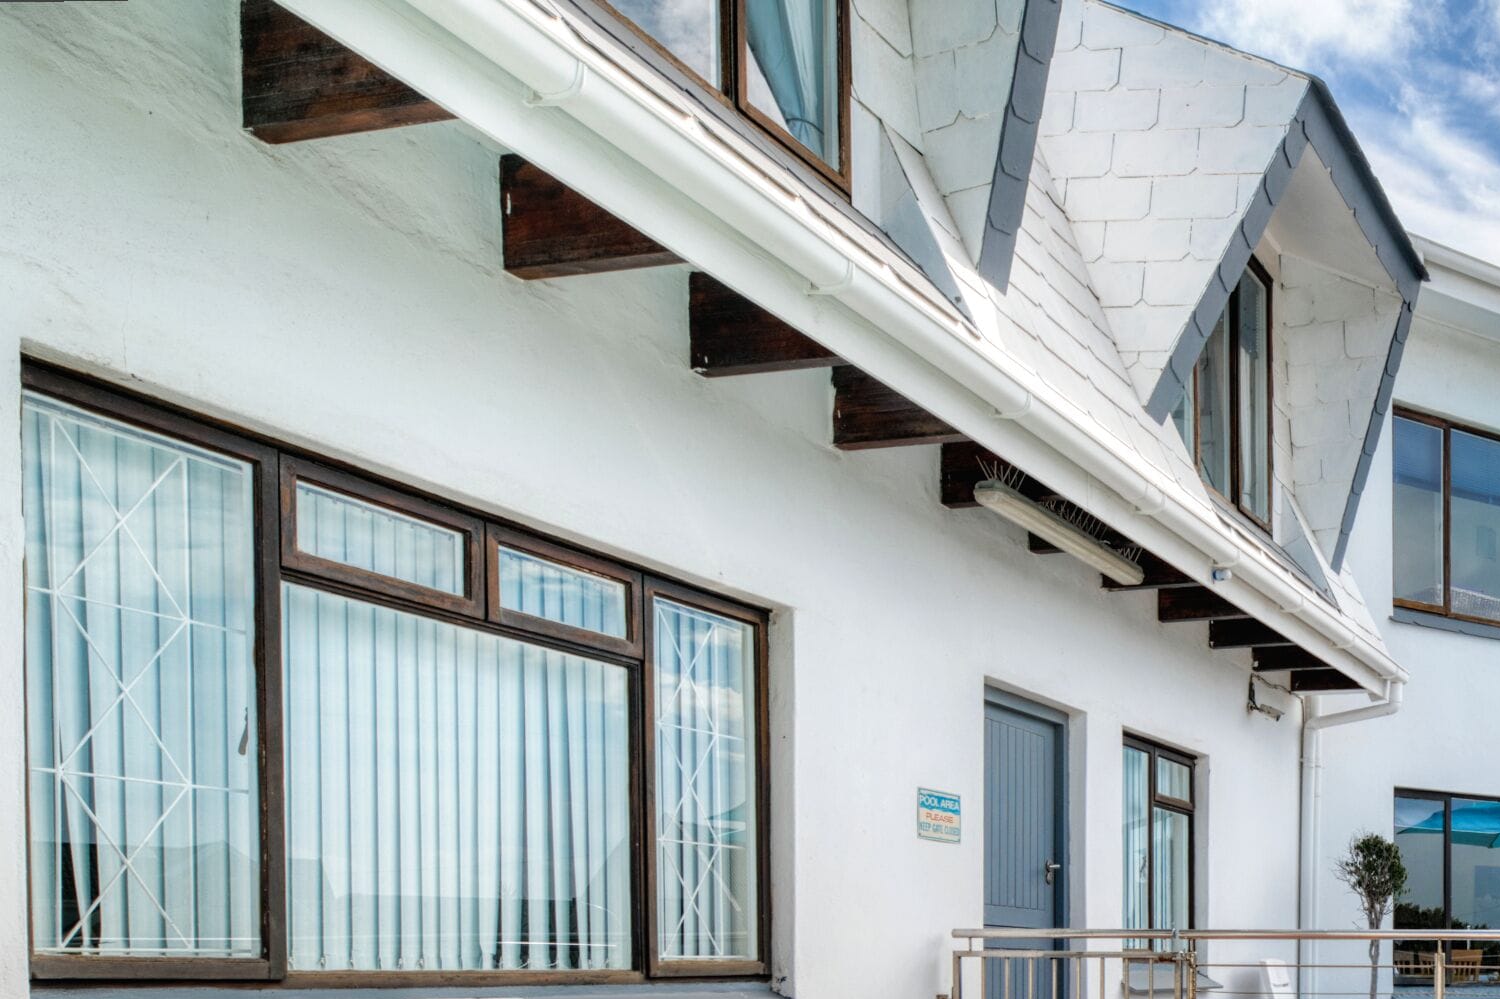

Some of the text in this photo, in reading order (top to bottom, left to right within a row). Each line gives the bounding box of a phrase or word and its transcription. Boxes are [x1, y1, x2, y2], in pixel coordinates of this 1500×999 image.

[920, 795, 960, 811] POOL AREA
[926, 812, 953, 823] PLEASE
